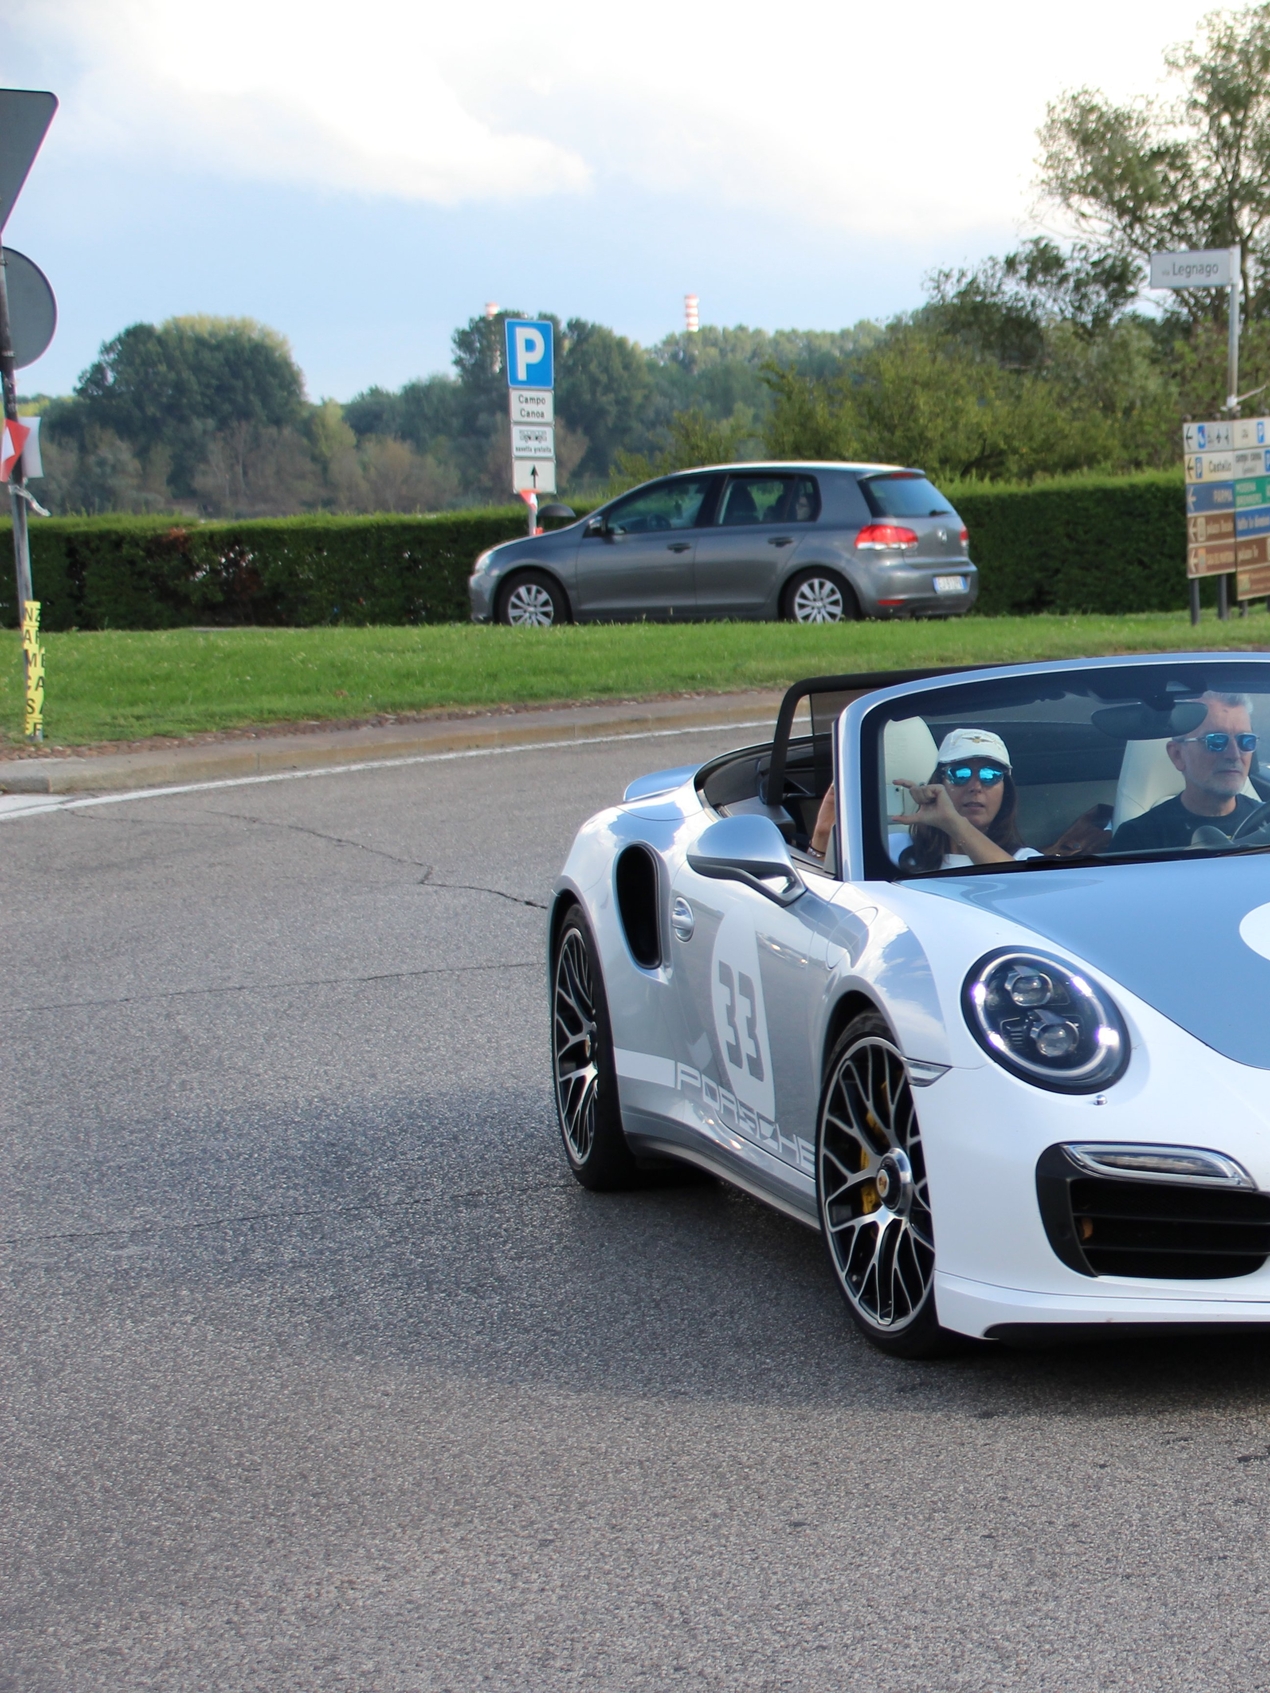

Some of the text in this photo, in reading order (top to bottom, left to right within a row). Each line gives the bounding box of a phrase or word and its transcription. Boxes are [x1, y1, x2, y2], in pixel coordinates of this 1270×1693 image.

[1172, 262, 1219, 278] Legnago
[515, 327, 545, 381] P
[518, 394, 546, 406] Campo
[520, 408, 545, 418] Canoa
[718, 959, 765, 1082] 33
[677, 1062, 816, 1174] PORSCHE
